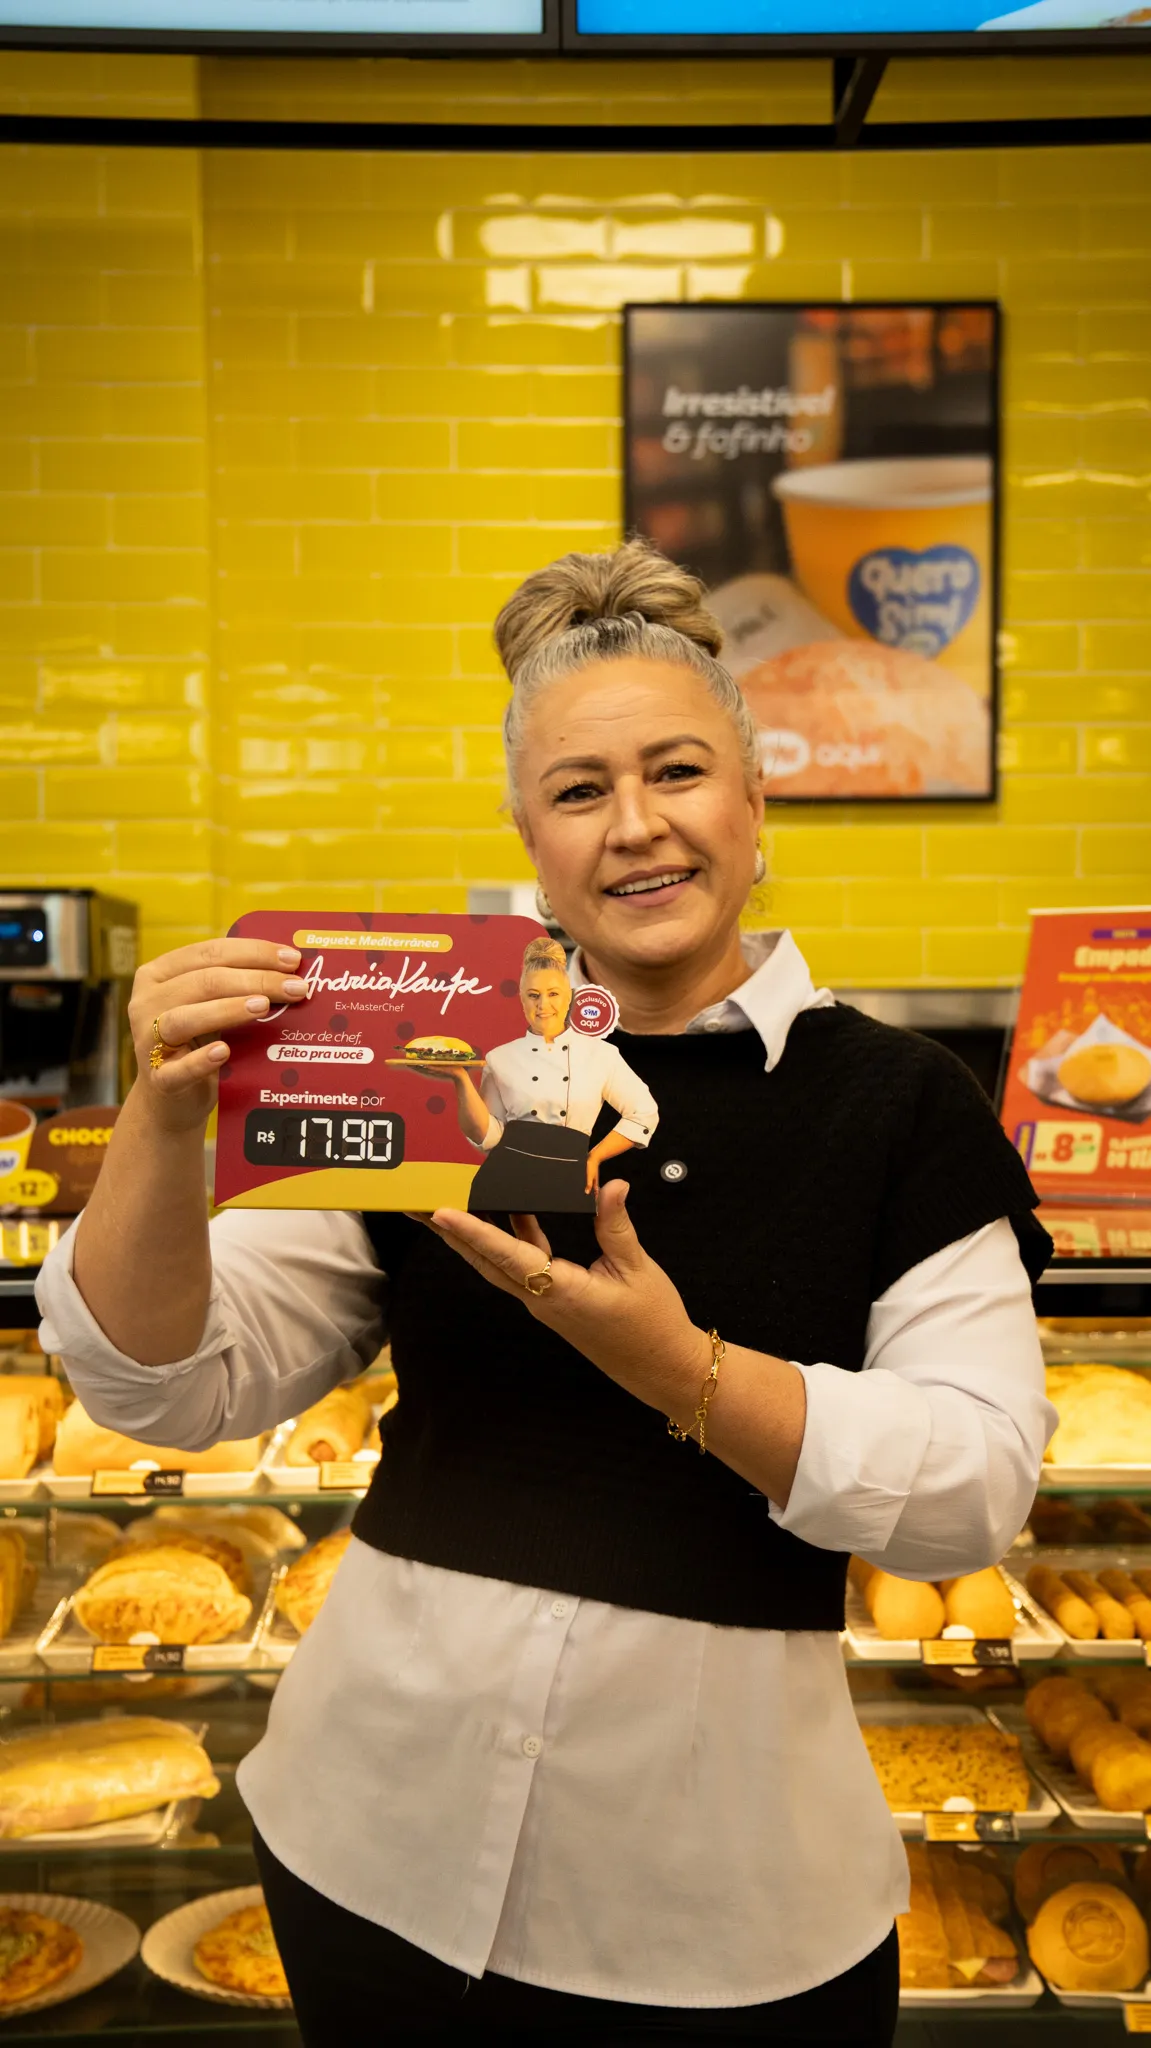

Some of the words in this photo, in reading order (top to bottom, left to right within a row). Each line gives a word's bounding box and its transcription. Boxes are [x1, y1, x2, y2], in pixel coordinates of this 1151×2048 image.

[691, 420, 813, 460] fofinho
[861, 557, 973, 602] Quero
[306, 934, 355, 947] Baguete
[358, 936, 440, 948] Mediterrânea
[335, 1002, 405, 1012] Ex-MasterChef
[576, 995, 607, 1008] Exclusivo
[280, 1029, 316, 1042] Sabor
[317, 1031, 332, 1042] de
[334, 1032, 362, 1044] chef,
[276, 1047, 308, 1060] feito
[309, 1050, 331, 1061] pra
[334, 1050, 364, 1060] você
[260, 1090, 358, 1106] Experimente
[360, 1096, 385, 1108] por
[257, 1130, 276, 1144] R$
[300, 1117, 393, 1162] 17.90
